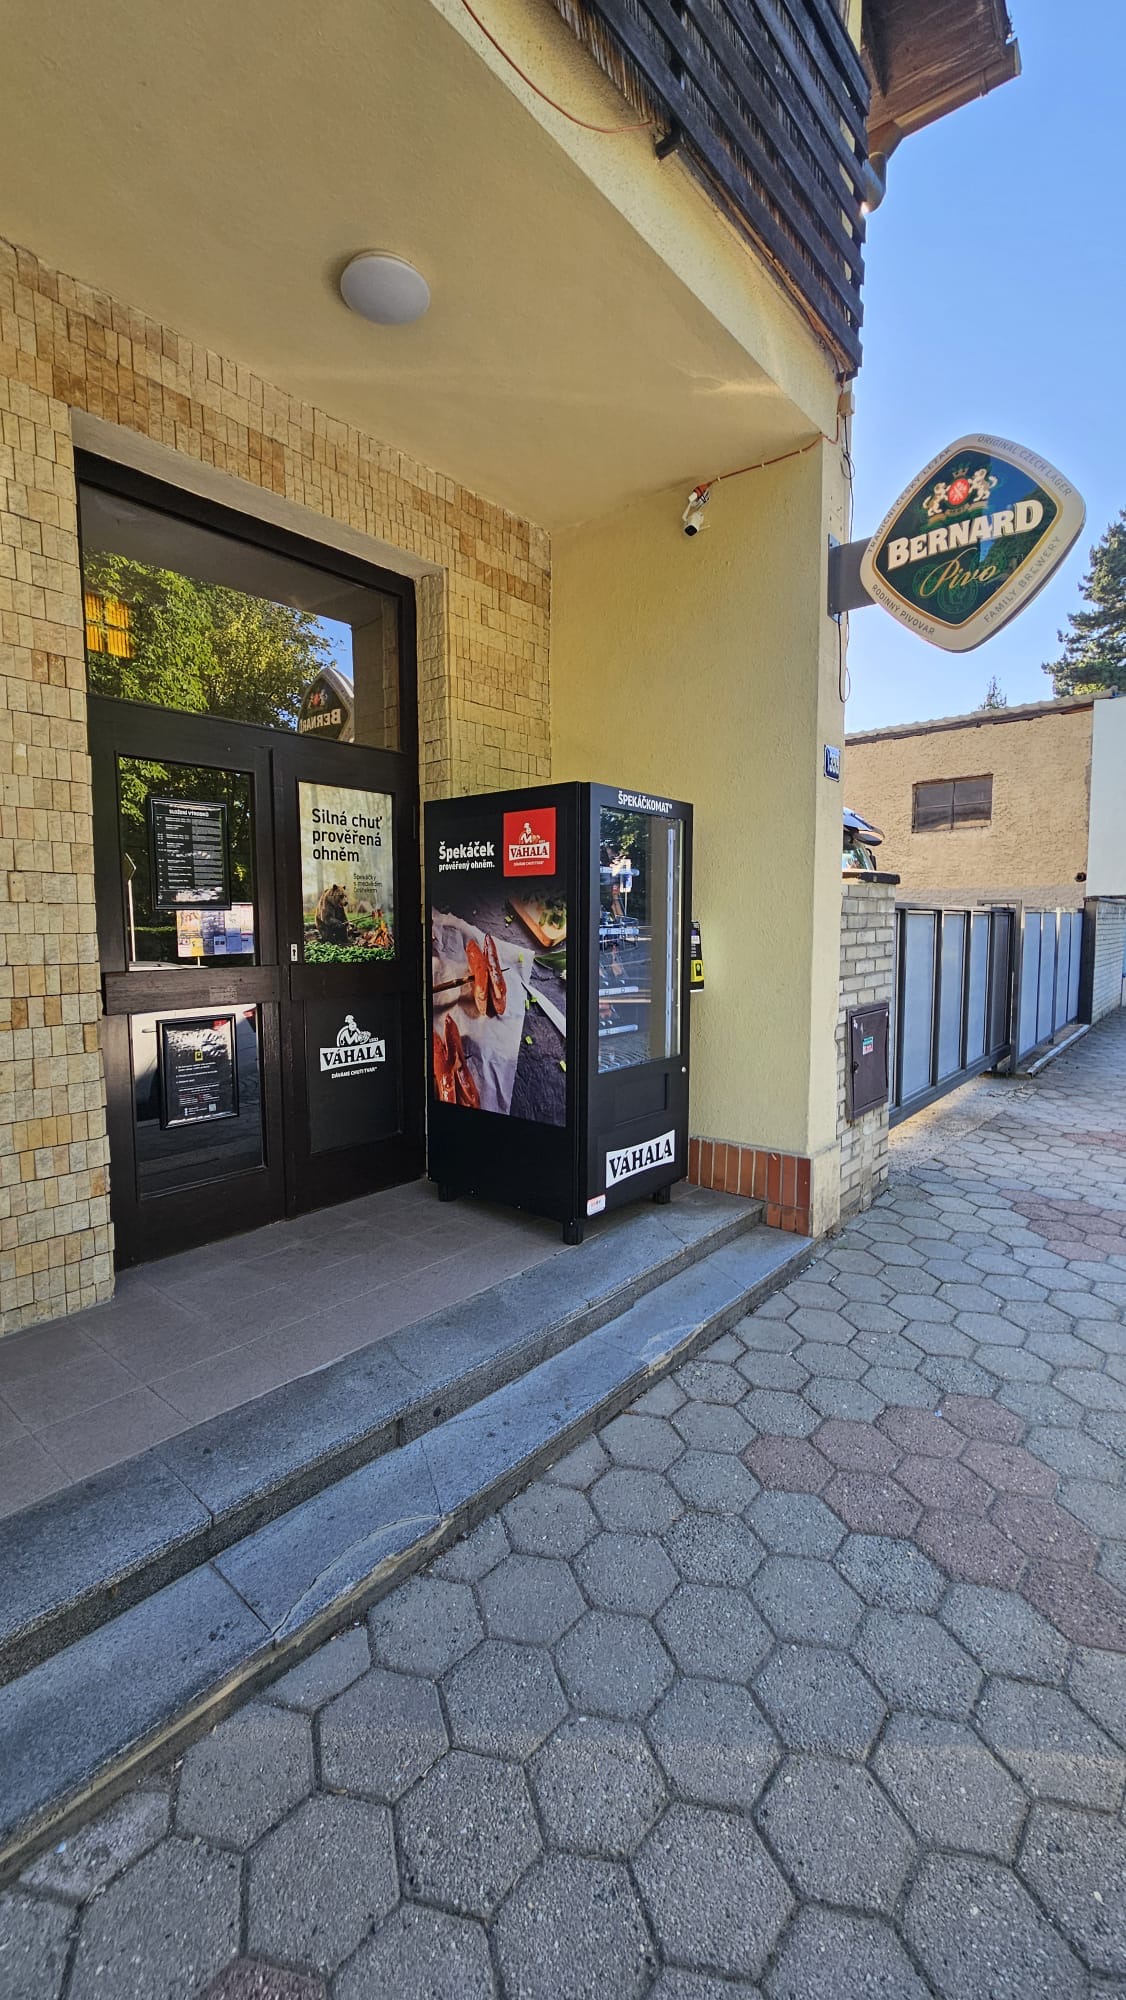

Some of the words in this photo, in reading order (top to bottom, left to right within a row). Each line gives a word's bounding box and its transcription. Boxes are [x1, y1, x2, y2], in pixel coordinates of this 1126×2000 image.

[977, 436, 1018, 455] ORIGINAL
[1020, 447, 1046, 472] CZECH
[1045, 468, 1073, 497] LAGER
[887, 499, 1044, 571] BERNARD
[920, 547, 1000, 597] Pivo
[983, 589, 1018, 623] FAMILY
[1018, 535, 1061, 588] BREWERY
[900, 610, 935, 635] PIVOVAR
[312, 808, 347, 826] Silná
[352, 813, 383, 829] chuť
[312, 829, 382, 847] prověřená
[312, 846, 360, 862] ohněm
[438, 840, 495, 862] Špekáček
[510, 845, 549, 858] VÁHALA
[438, 860, 470, 872] prověřený
[322, 1045, 384, 1067] VÁHALA
[608, 1138, 673, 1179] VÁHALA
